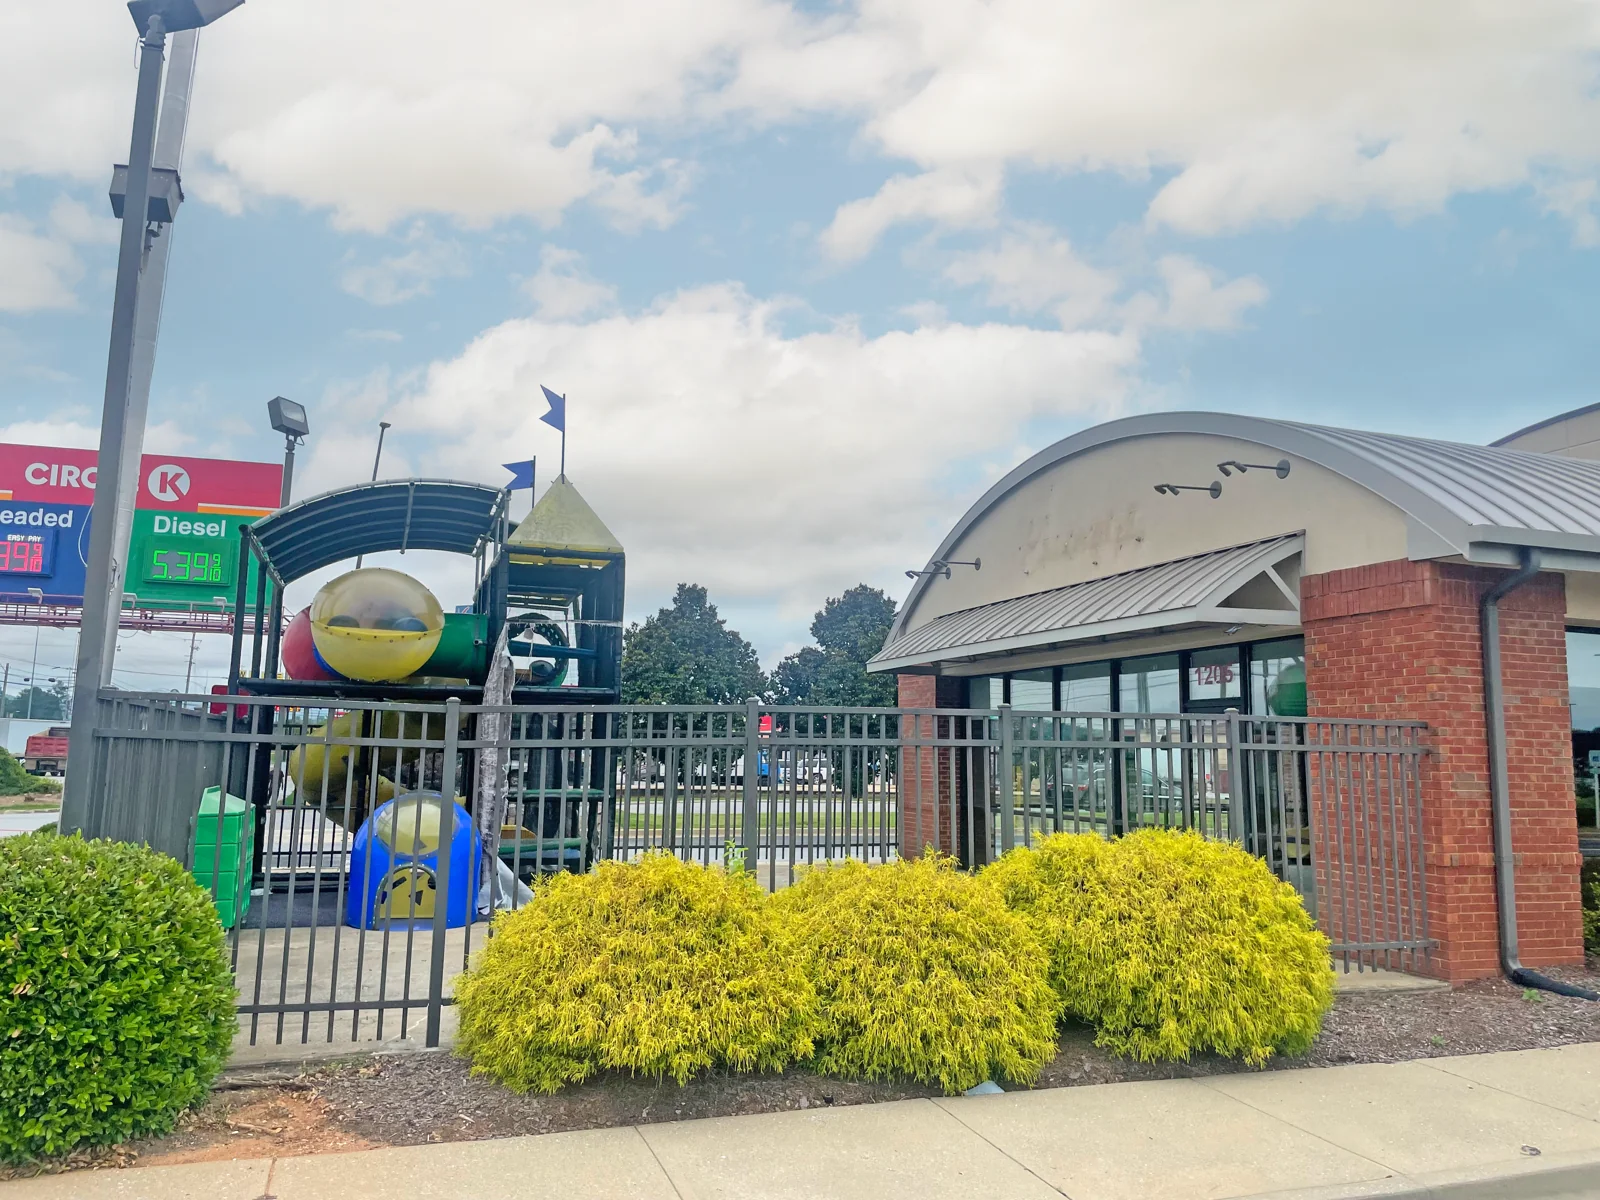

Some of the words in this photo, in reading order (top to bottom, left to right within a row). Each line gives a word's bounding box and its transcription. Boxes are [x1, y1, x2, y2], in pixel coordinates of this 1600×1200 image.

[154, 515, 226, 537] Diesel
[7, 534, 25, 542] EASY
[1195, 662, 1234, 685] 1205
